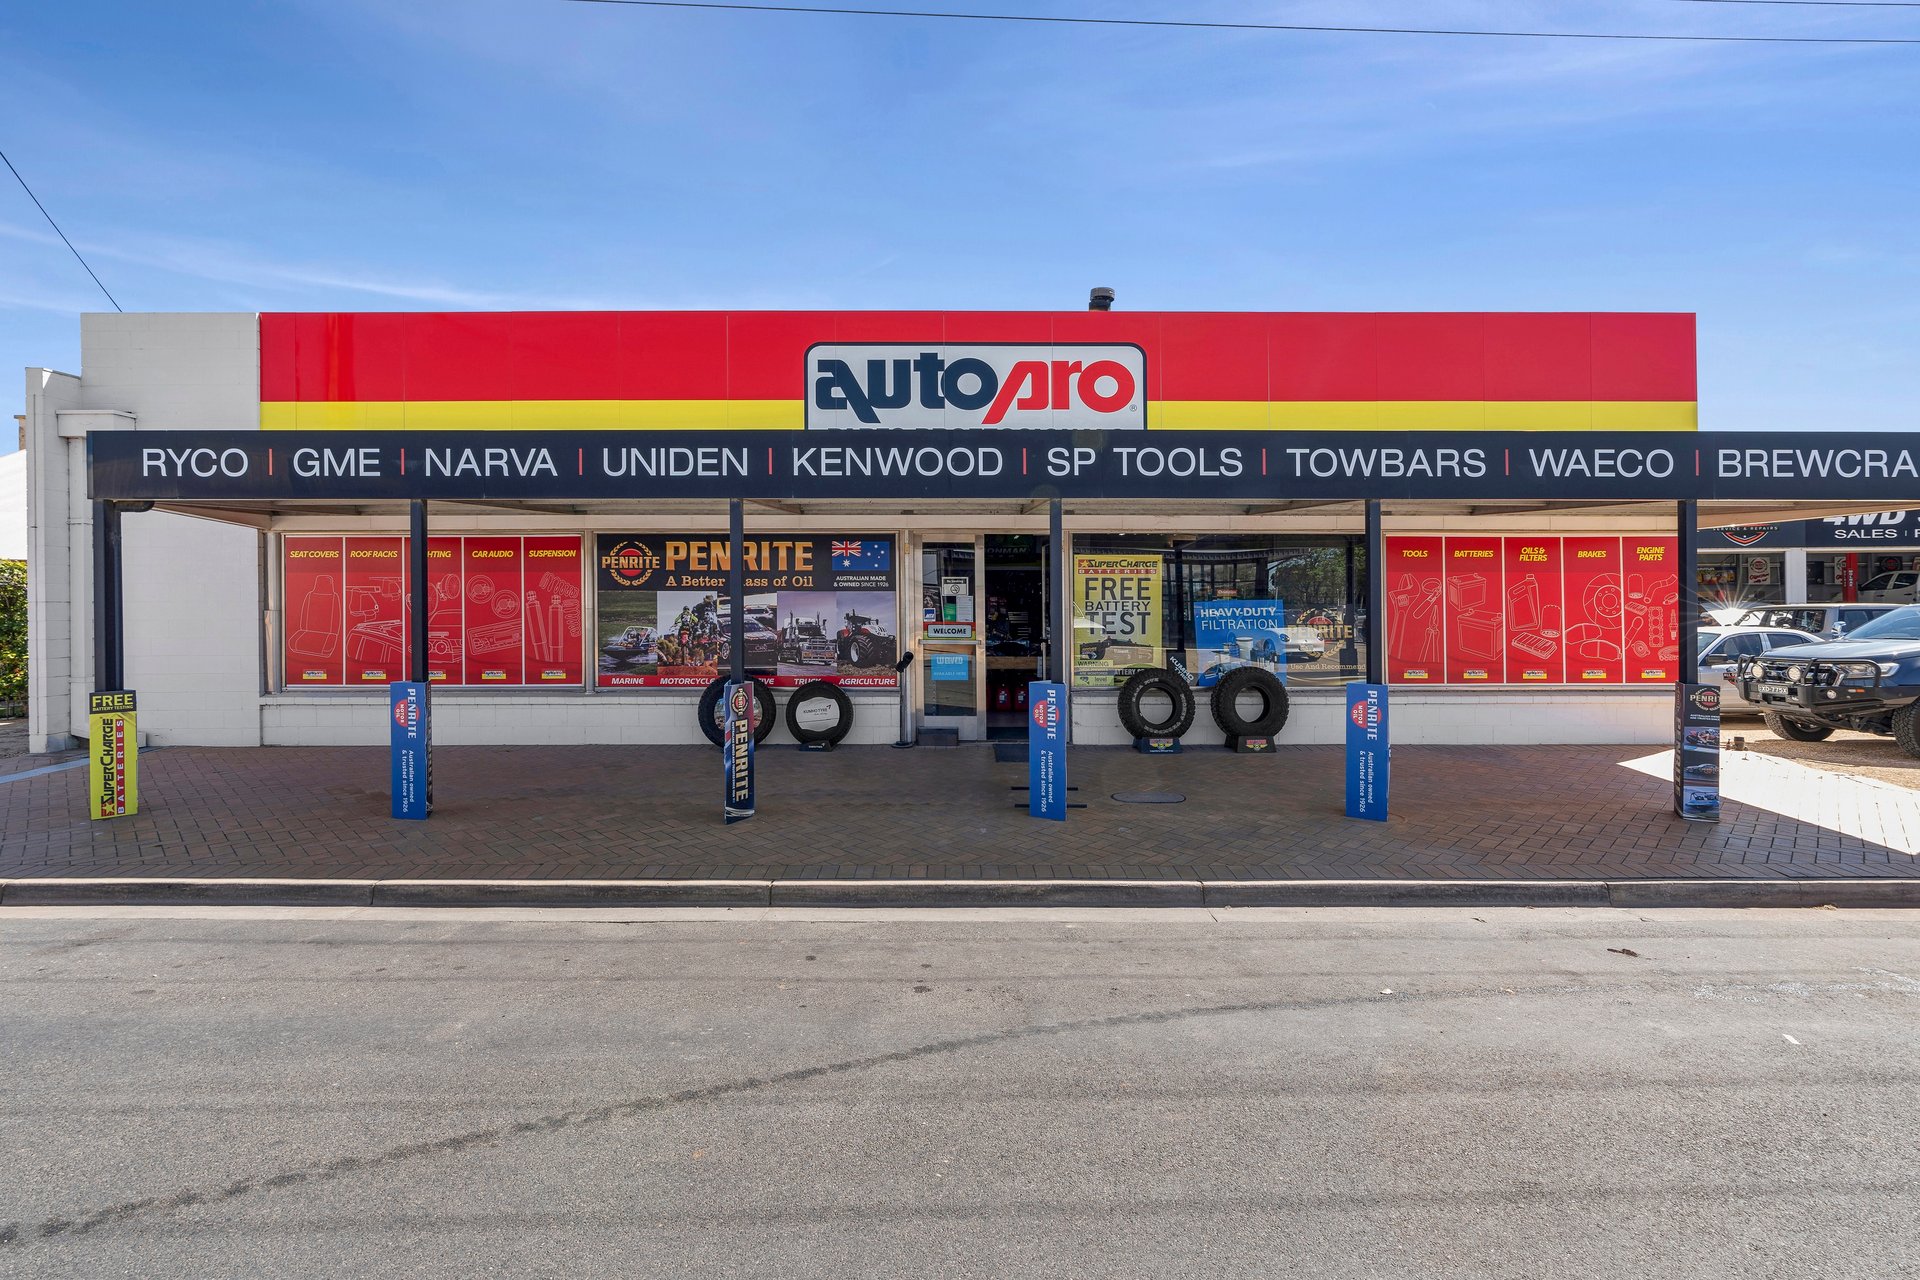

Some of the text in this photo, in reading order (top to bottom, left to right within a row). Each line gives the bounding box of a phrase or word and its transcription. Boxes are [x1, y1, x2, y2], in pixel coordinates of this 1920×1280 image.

[142, 448, 249, 478] RYCO
[293, 447, 381, 477] GME
[425, 447, 558, 477] NARVA
[603, 447, 748, 476] UNIDEN
[793, 447, 1003, 477] KENWOOD
[1047, 447, 1096, 476] SP
[1113, 448, 1243, 477] TOOLS
[1286, 448, 1487, 477] TOWBARS
[1529, 449, 1675, 478] WAECO
[1834, 529, 1898, 539] SALES
[290, 550, 339, 558] SEAT COVERS
[350, 550, 398, 558] ROOF RACKS
[427, 550, 452, 558] HTING
[472, 550, 514, 558] CAR AUDIO
[528, 550, 577, 558] SUSPENSION
[1402, 550, 1428, 558] TOOLS
[1453, 550, 1494, 558] BATTERIES
[1577, 550, 1607, 558] BRAKES
[1636, 546, 1665, 554] ENGINE
[665, 541, 814, 571] PENRITE
[1519, 554, 1548, 562] FILTERS
[601, 556, 660, 569] PENRITE
[665, 575, 814, 587] A Better ass of Oil
[1085, 577, 1152, 601] FREE
[1085, 601, 1151, 611] BATTERY
[1200, 607, 1277, 618] HEAVY-DUTY
[1085, 612, 1151, 635] TEST
[1201, 619, 1278, 630] FILTRATION
[1169, 656, 1194, 680] KUMHO
[611, 677, 645, 685] MARINE
[92, 694, 134, 707] FREE
[408, 688, 417, 739] PENRITE
[1046, 689, 1056, 740] PENRITE
[1367, 690, 1378, 740] PENRITE
[735, 719, 748, 802] PENRITE
[116, 720, 124, 814] BATTERIES
